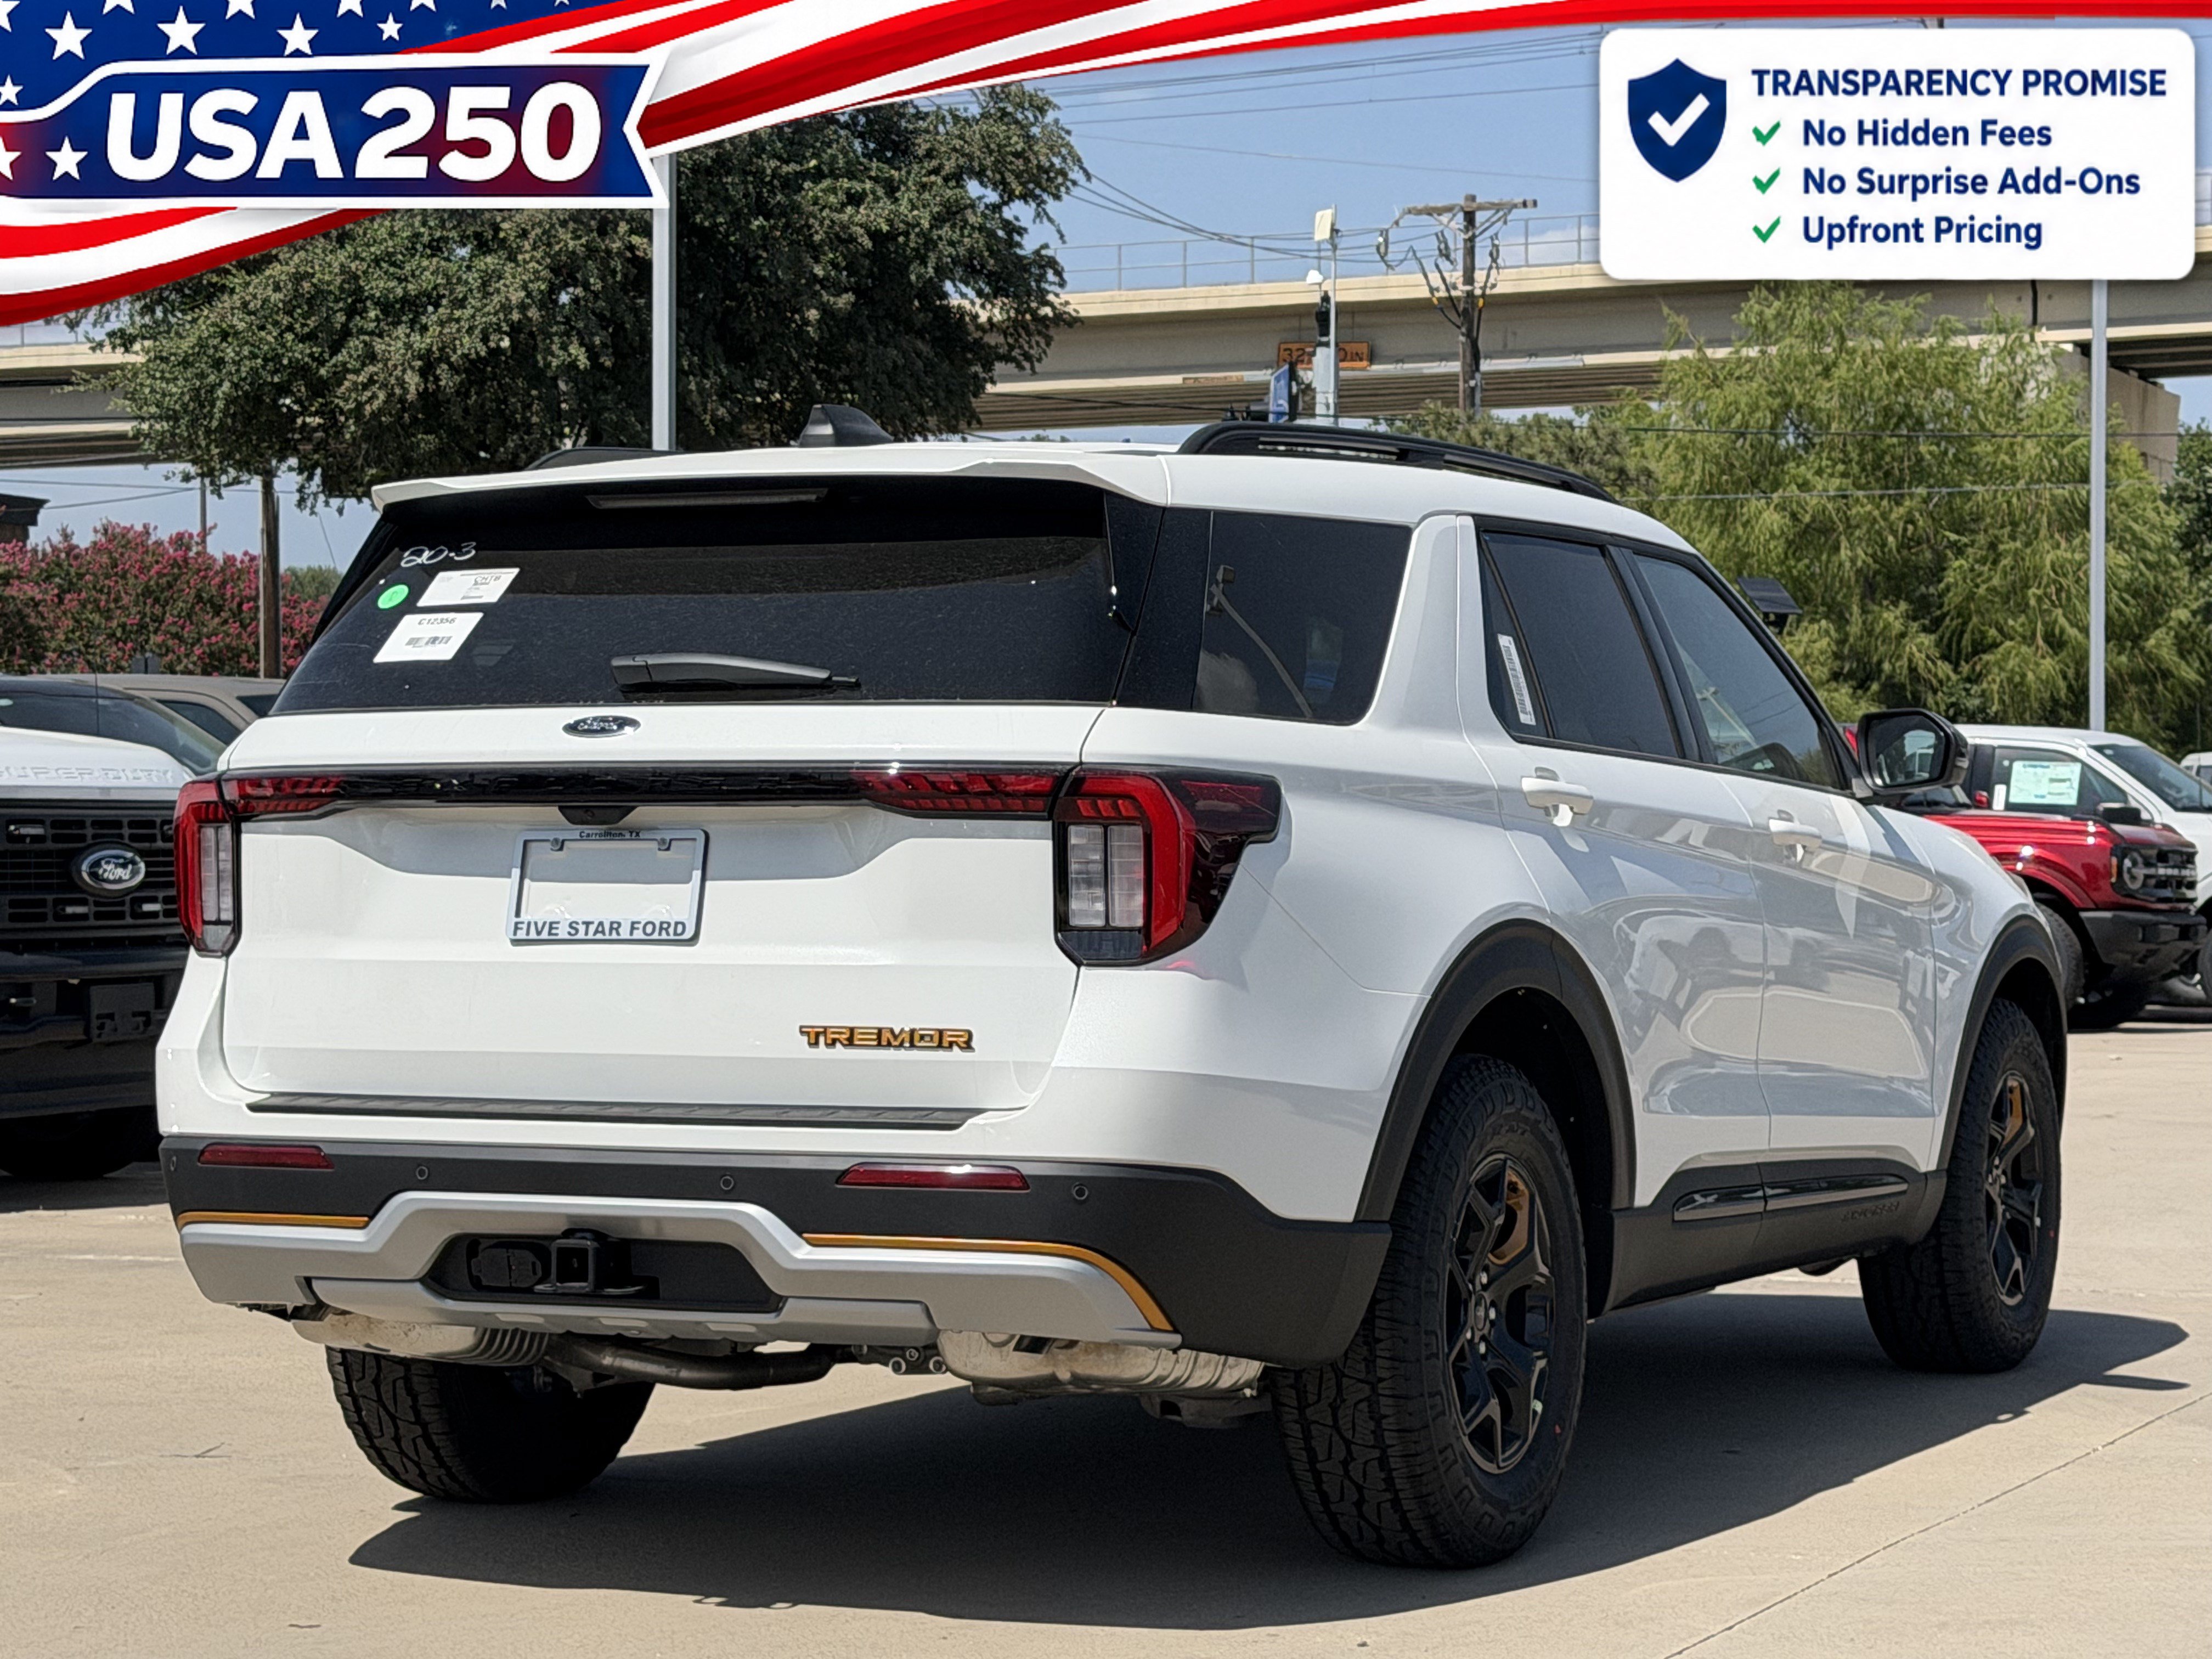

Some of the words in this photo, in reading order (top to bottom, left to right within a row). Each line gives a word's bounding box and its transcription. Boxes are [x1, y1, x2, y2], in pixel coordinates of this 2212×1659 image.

[628, 830, 641, 838] TX
[98, 857, 133, 881] Ford
[512, 920, 561, 937] FIVE
[567, 920, 623, 937] STAR
[629, 920, 687, 937] FORD
[799, 1025, 974, 1052] TREMOR
